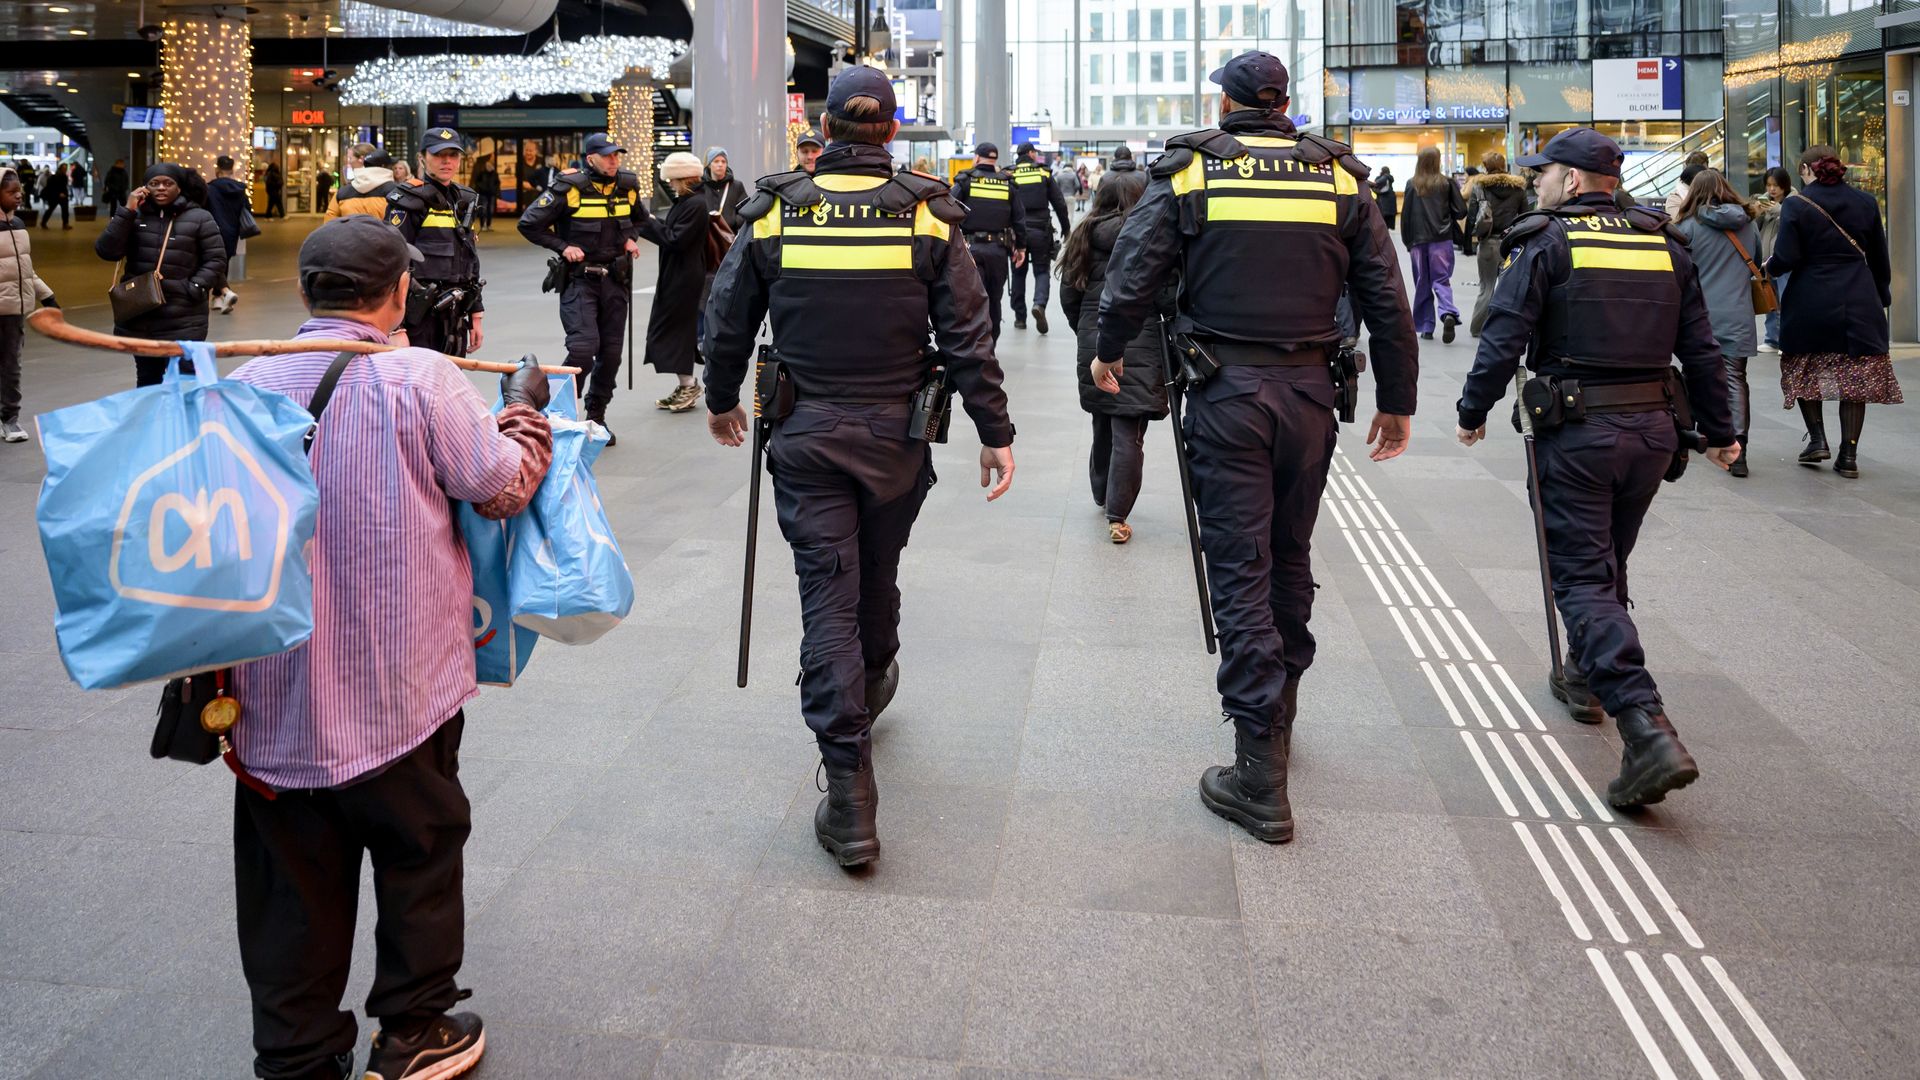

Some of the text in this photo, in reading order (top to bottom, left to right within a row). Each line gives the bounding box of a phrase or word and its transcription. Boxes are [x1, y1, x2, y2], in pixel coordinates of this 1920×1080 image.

[292, 110, 325, 125] KIOSK
[1351, 105, 1505, 121] OV Service & Tickets
